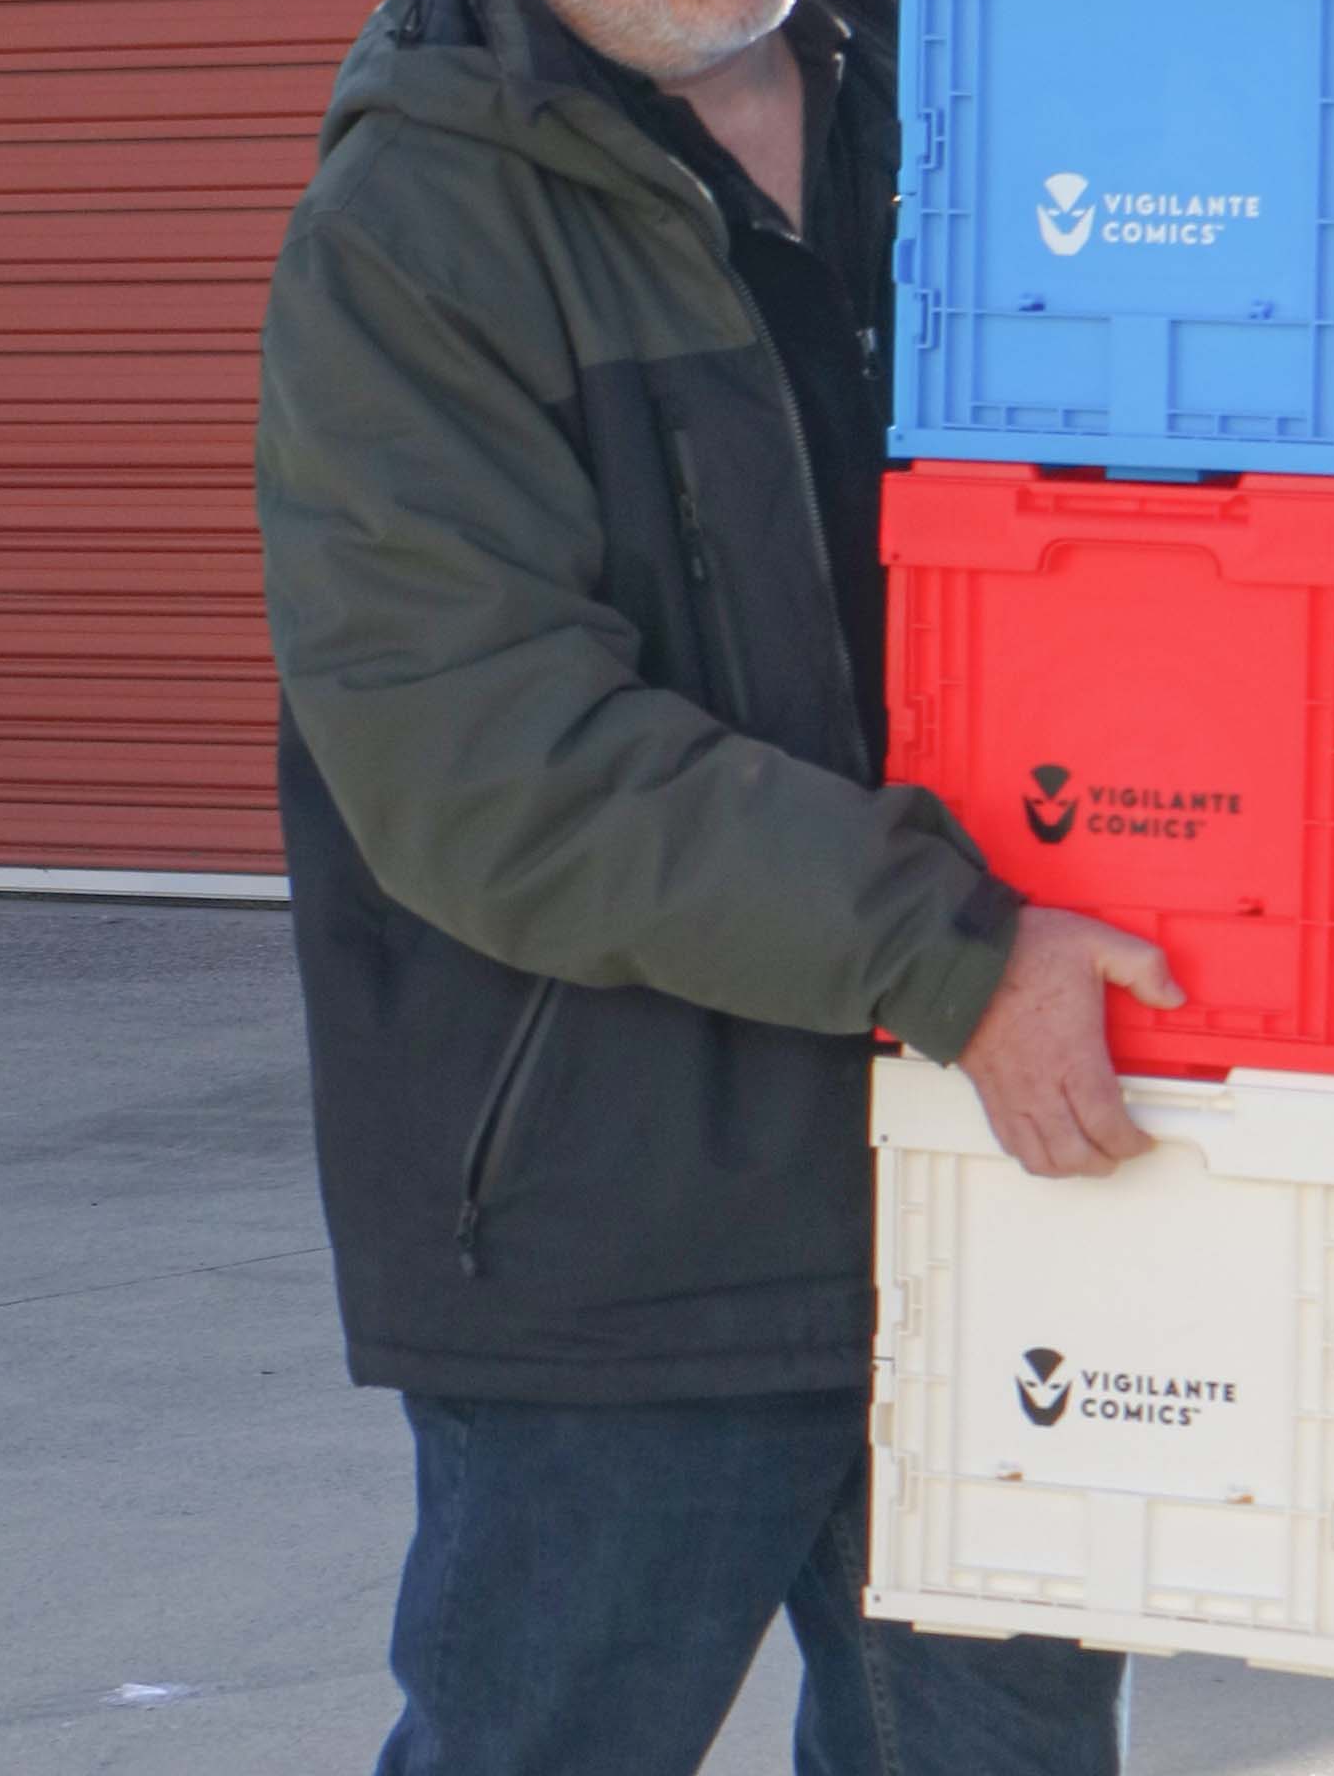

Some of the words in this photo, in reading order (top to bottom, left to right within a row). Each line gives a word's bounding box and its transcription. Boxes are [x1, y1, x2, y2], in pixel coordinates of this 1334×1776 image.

[1103, 193, 1260, 218] VIGILANTE
[1088, 786, 1242, 814] VIGILANTE
[1081, 1370, 1237, 1403] VIGILANTE
